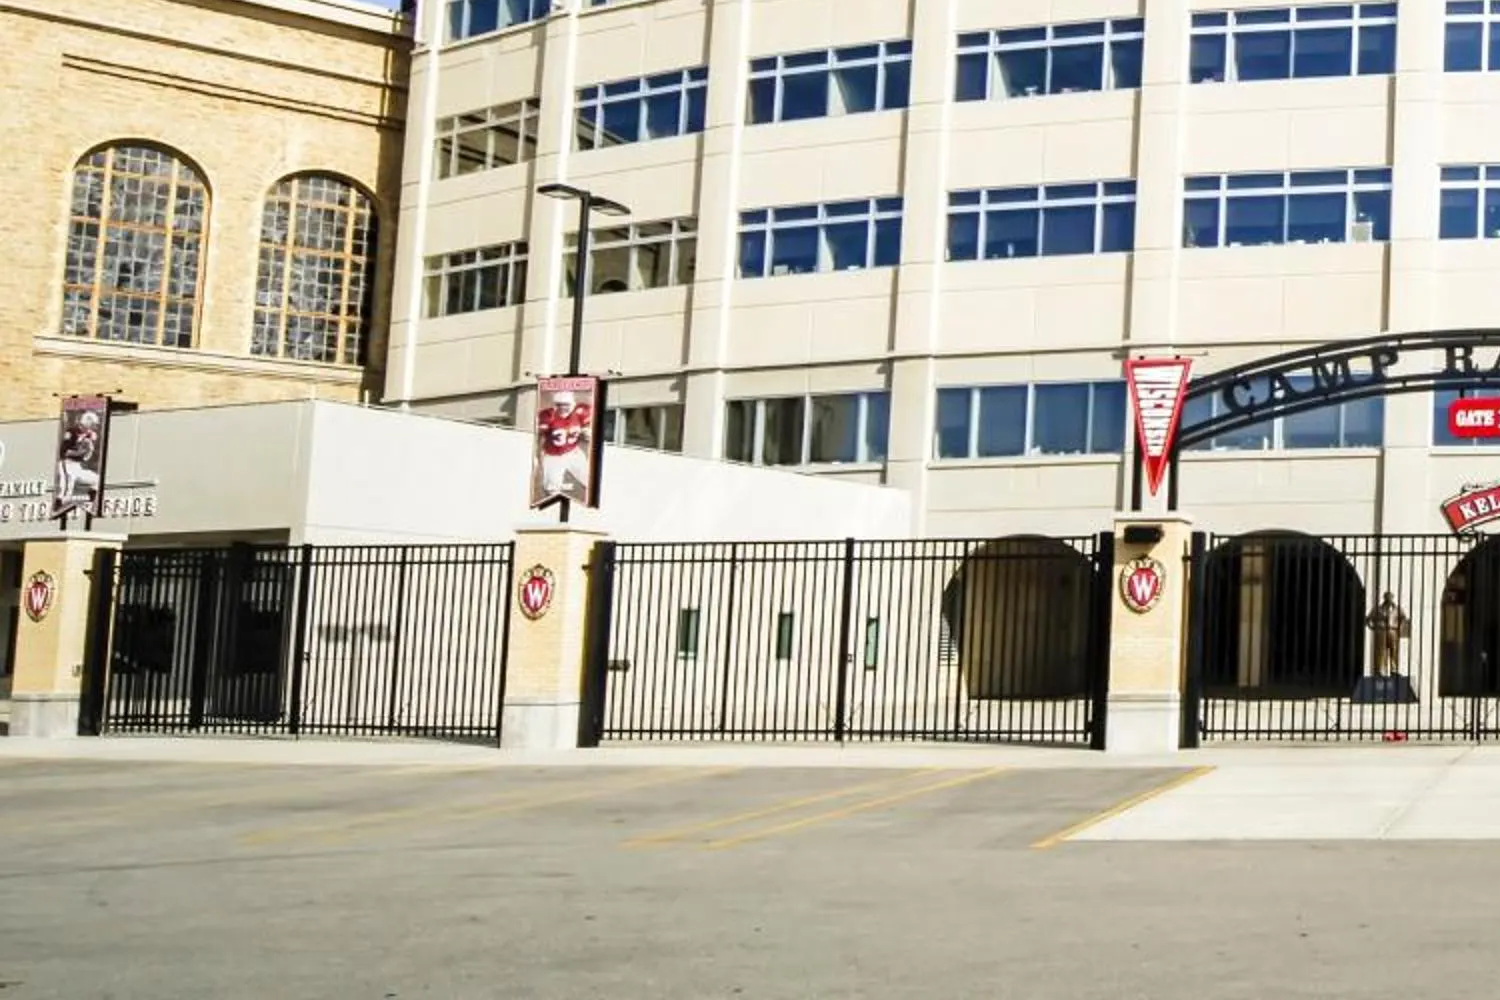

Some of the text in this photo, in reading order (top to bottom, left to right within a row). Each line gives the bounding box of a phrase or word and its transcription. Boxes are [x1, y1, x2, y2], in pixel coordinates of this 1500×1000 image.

[1222, 348, 1399, 412] CAMP
[1455, 408, 1495, 428] GATE
[30, 587, 48, 610] W
[526, 583, 549, 607] W
[1131, 574, 1158, 600] W
